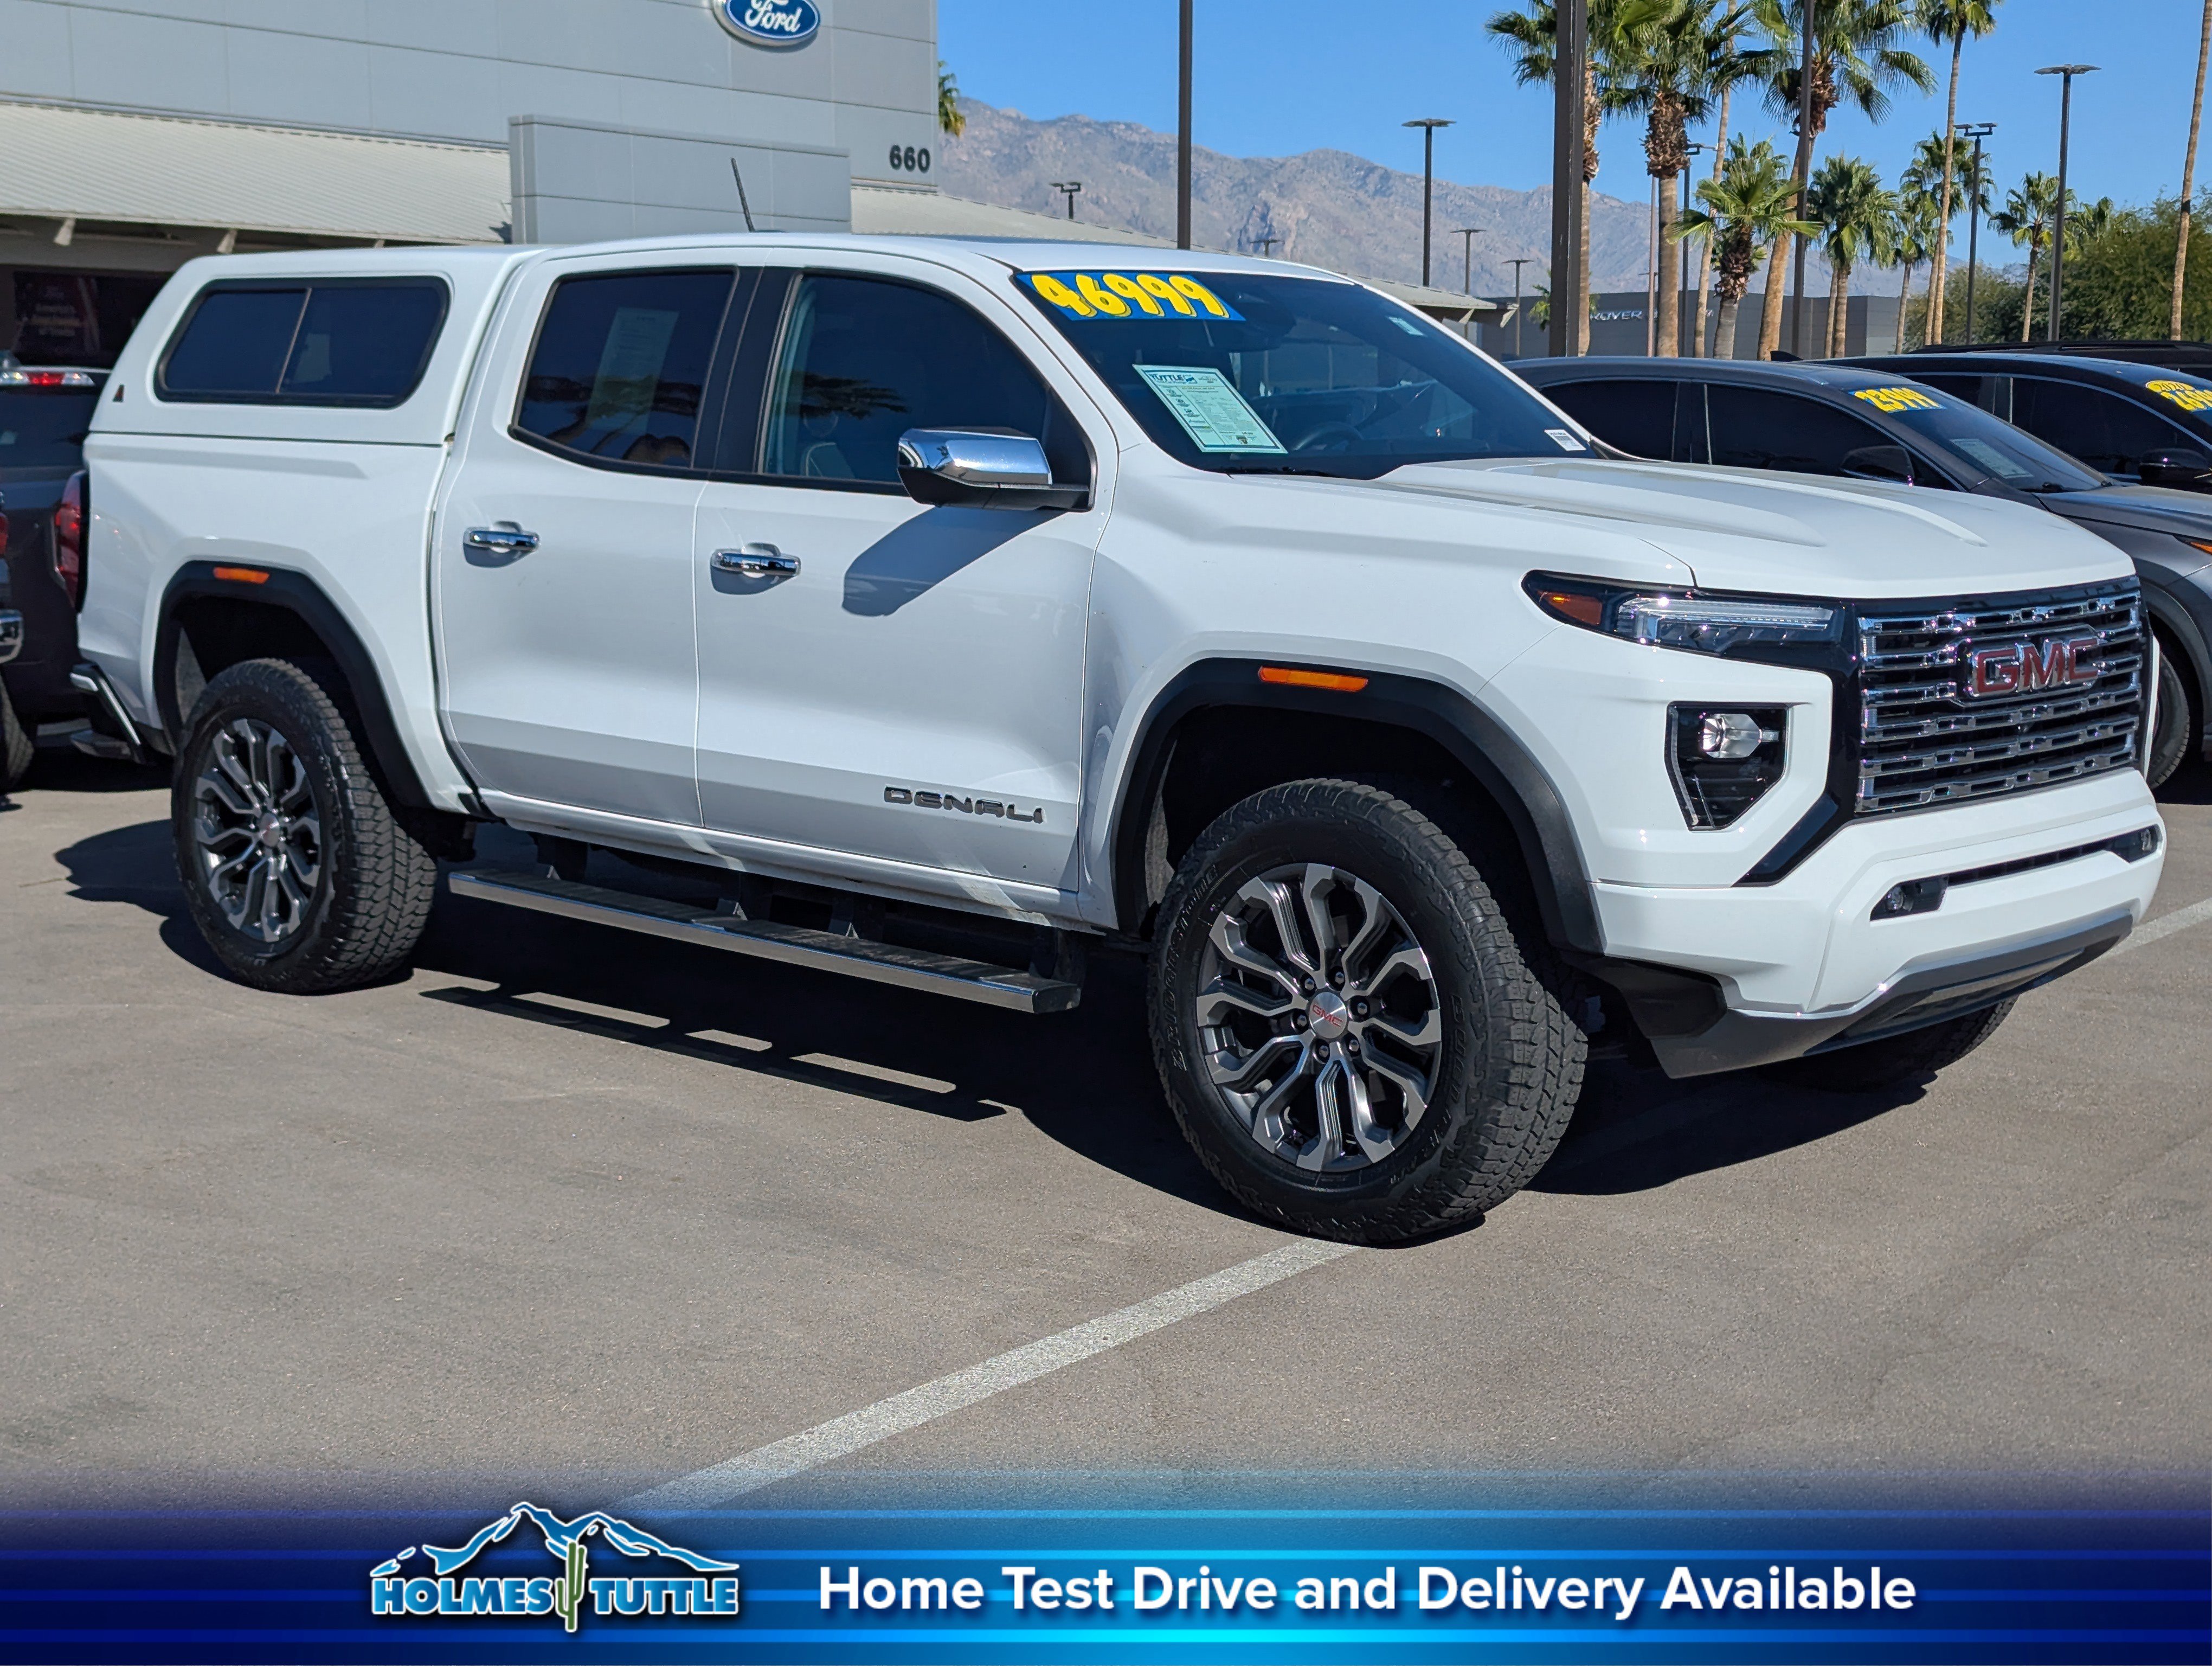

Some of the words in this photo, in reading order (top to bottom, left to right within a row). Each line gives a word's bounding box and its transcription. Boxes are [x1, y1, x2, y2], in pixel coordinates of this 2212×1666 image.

[744, 0, 803, 33] Ford
[889, 144, 931, 174] 660
[1031, 274, 1230, 317] 46999
[2160, 389, 2212, 411] 2699
[1971, 637, 2100, 698] GMC
[883, 786, 1045, 824] DENALI
[1312, 1003, 1343, 1028] GMC
